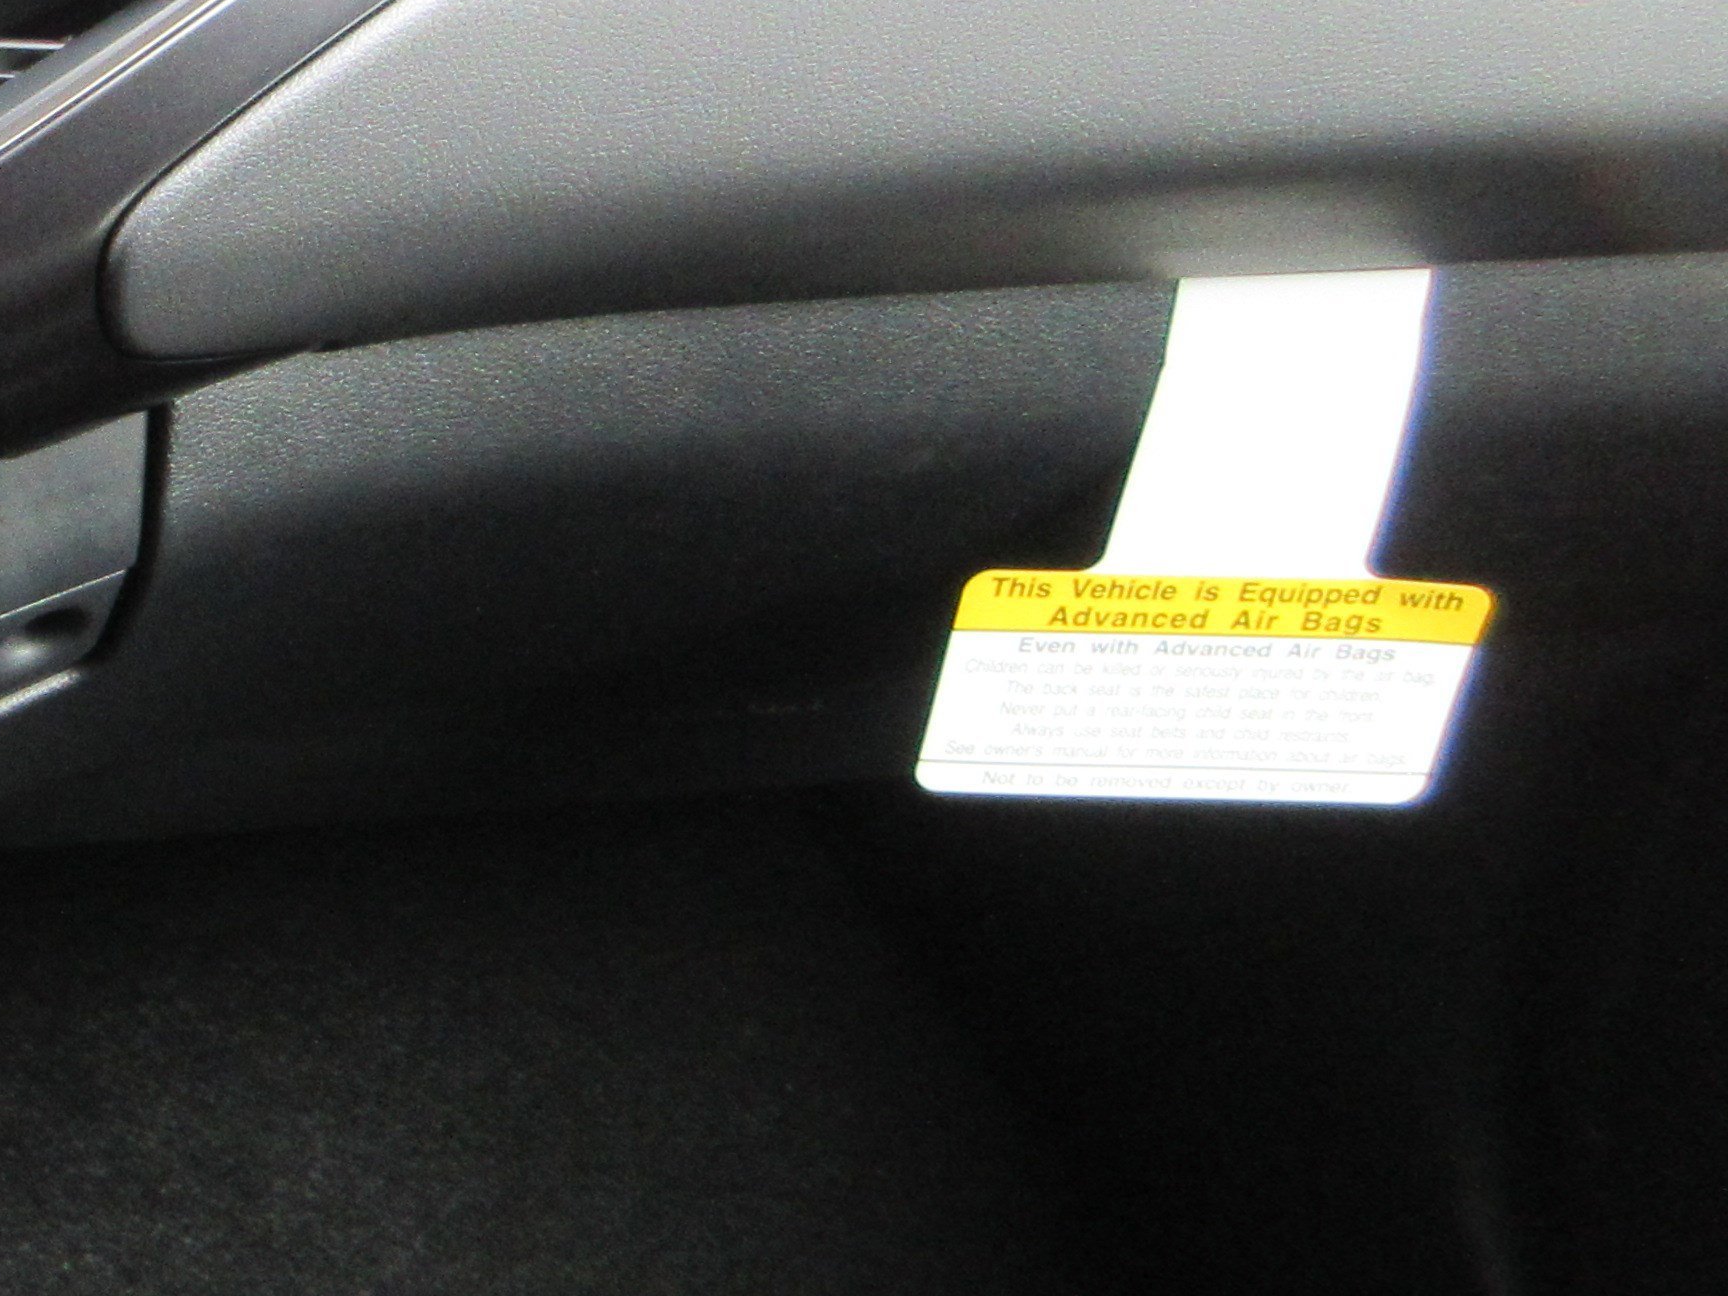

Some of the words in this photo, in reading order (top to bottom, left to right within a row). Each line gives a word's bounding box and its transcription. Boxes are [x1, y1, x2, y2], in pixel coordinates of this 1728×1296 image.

[990, 576, 1052, 600] This
[1072, 578, 1178, 602] Vehicle
[1194, 580, 1221, 603] is
[1238, 581, 1384, 609] Equipped
[1399, 589, 1466, 613] with
[1045, 605, 1211, 631] Advanced
[1230, 609, 1280, 632] Air
[1300, 610, 1384, 637] Bags
[1018, 636, 1077, 655] Even
[1090, 638, 1140, 656] with
[1153, 639, 1273, 658] Advanced
[1286, 642, 1323, 660] Air
[1334, 643, 1398, 665] Bags
[964, 657, 1029, 675] Children
[944, 739, 977, 757] See
[981, 770, 1016, 786] Not
